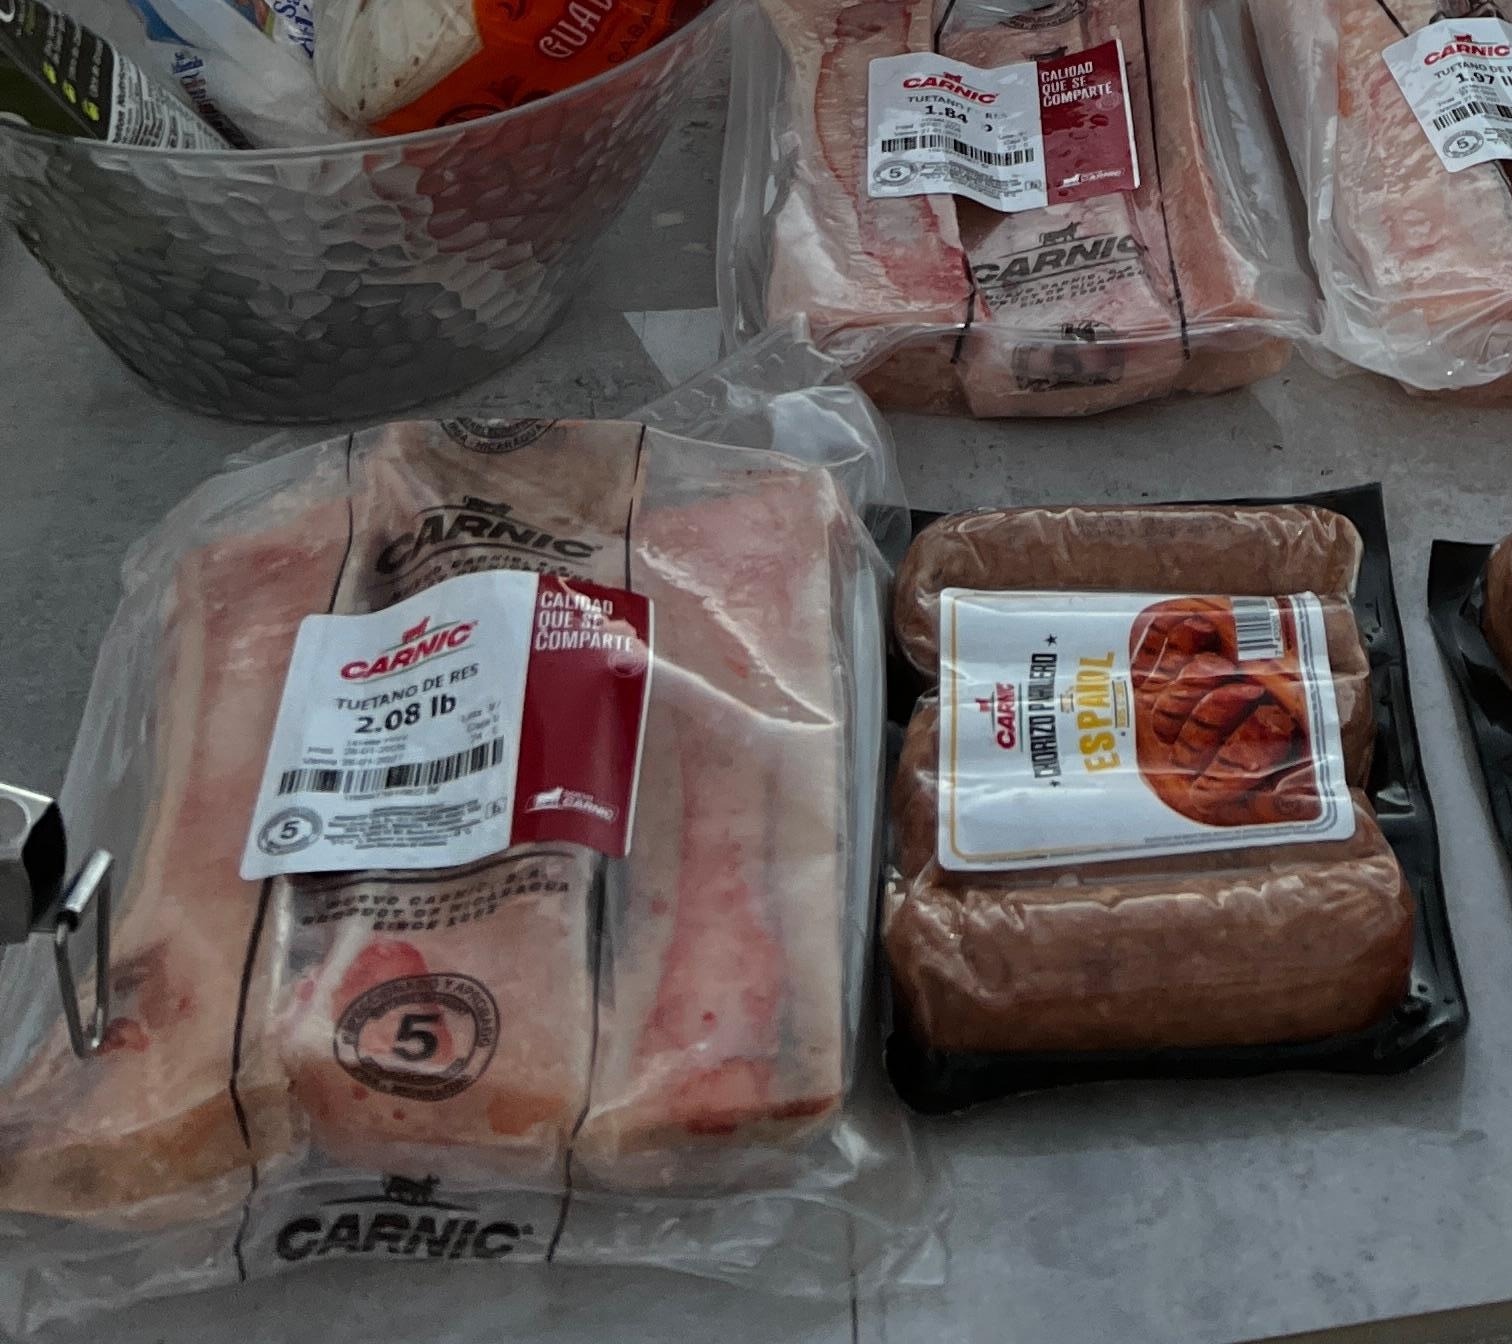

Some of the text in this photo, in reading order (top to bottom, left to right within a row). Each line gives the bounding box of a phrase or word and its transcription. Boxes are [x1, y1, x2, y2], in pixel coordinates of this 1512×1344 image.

[1424, 43, 1511, 66] CARNIC
[1041, 61, 1093, 83] CALIDAD
[903, 76, 998, 104] CARNIC
[1042, 77, 1087, 97] QUE SE
[1043, 81, 1113, 108] COMPARTE
[375, 513, 598, 574] CARNIC
[540, 591, 614, 615] CALIDAD
[539, 610, 574, 630] QUE
[341, 622, 475, 681] CARNIC
[534, 630, 634, 652] COMPARTE
[335, 663, 479, 712] TUETANO DE RES
[354, 694, 456, 734] 2.08 lb
[280, 820, 300, 841] 5
[392, 1013, 441, 1062] 5
[276, 1213, 521, 1261] CARNIC
